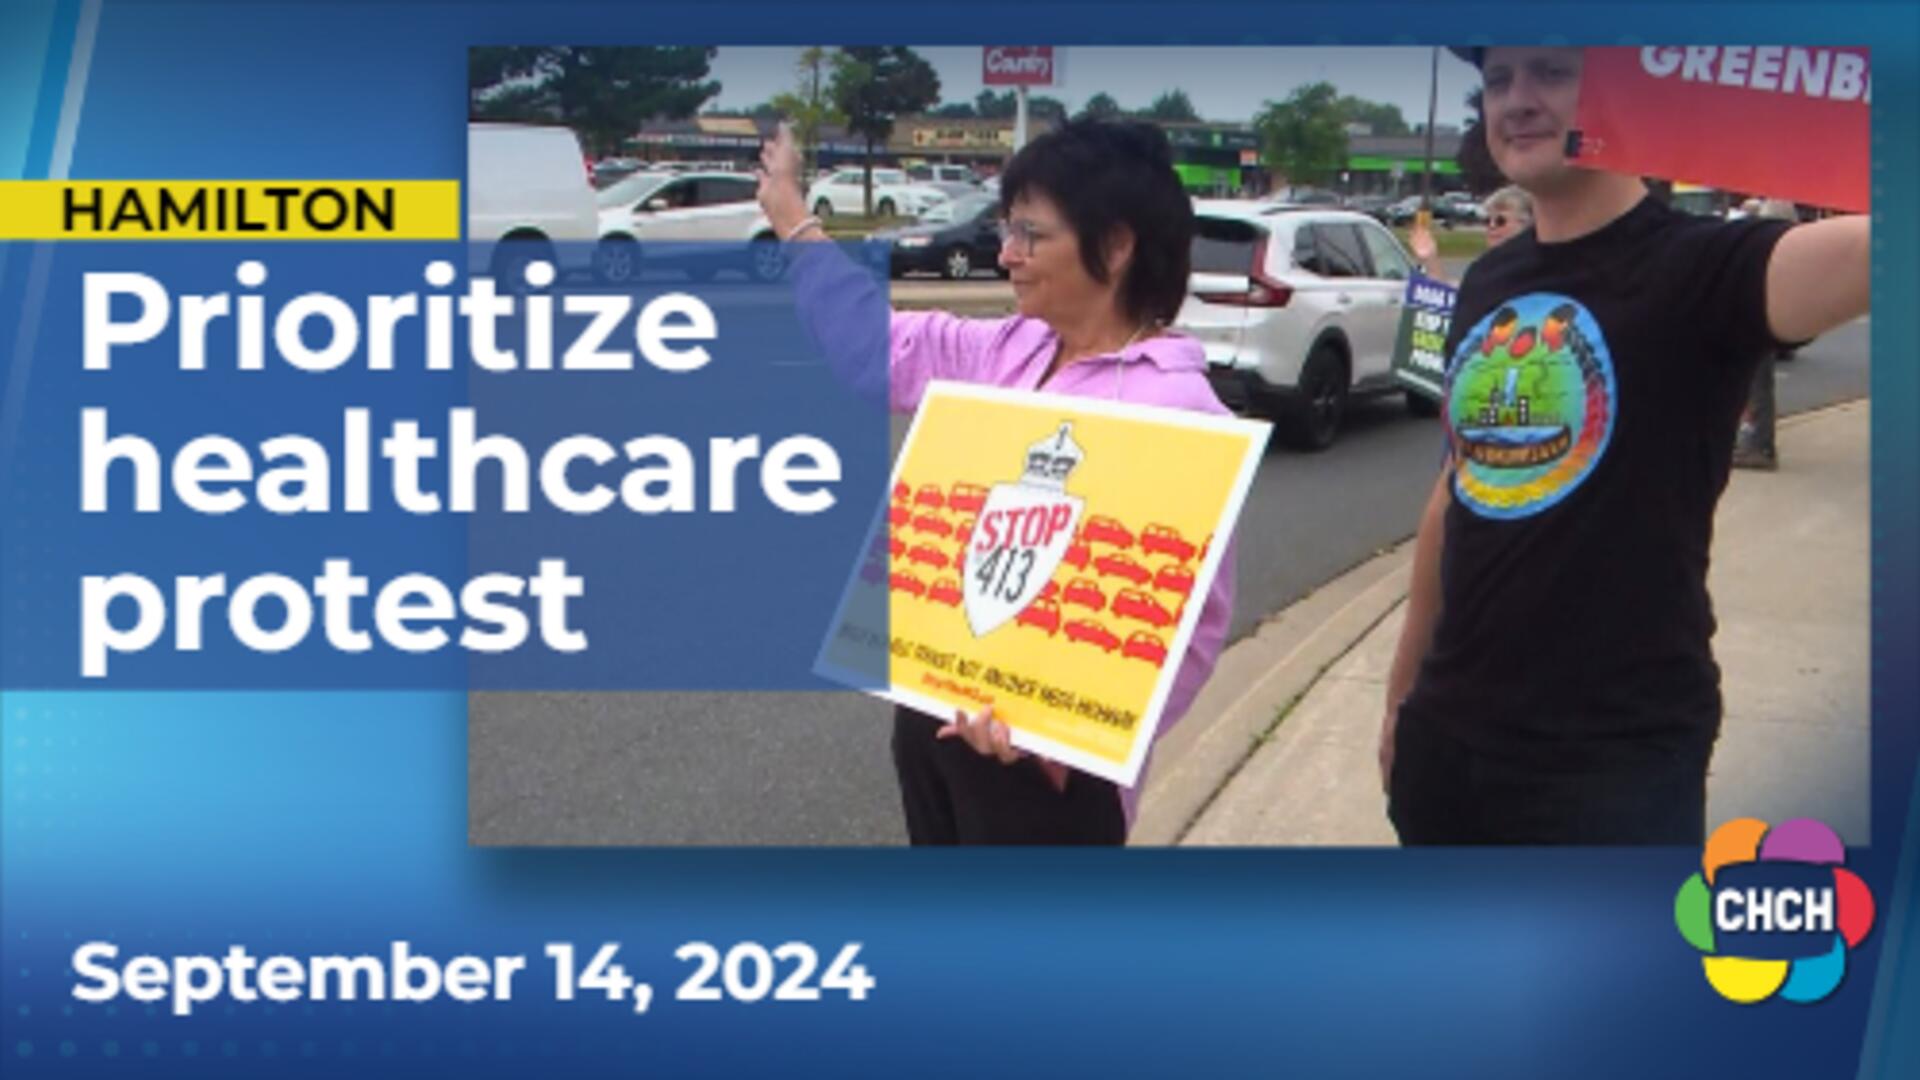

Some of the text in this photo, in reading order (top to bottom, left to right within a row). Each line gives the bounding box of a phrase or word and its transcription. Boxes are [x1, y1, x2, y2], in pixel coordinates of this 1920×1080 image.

[1640, 46, 1871, 104] GREENB
[975, 502, 1072, 553] STOP
[975, 543, 1036, 604] 413
